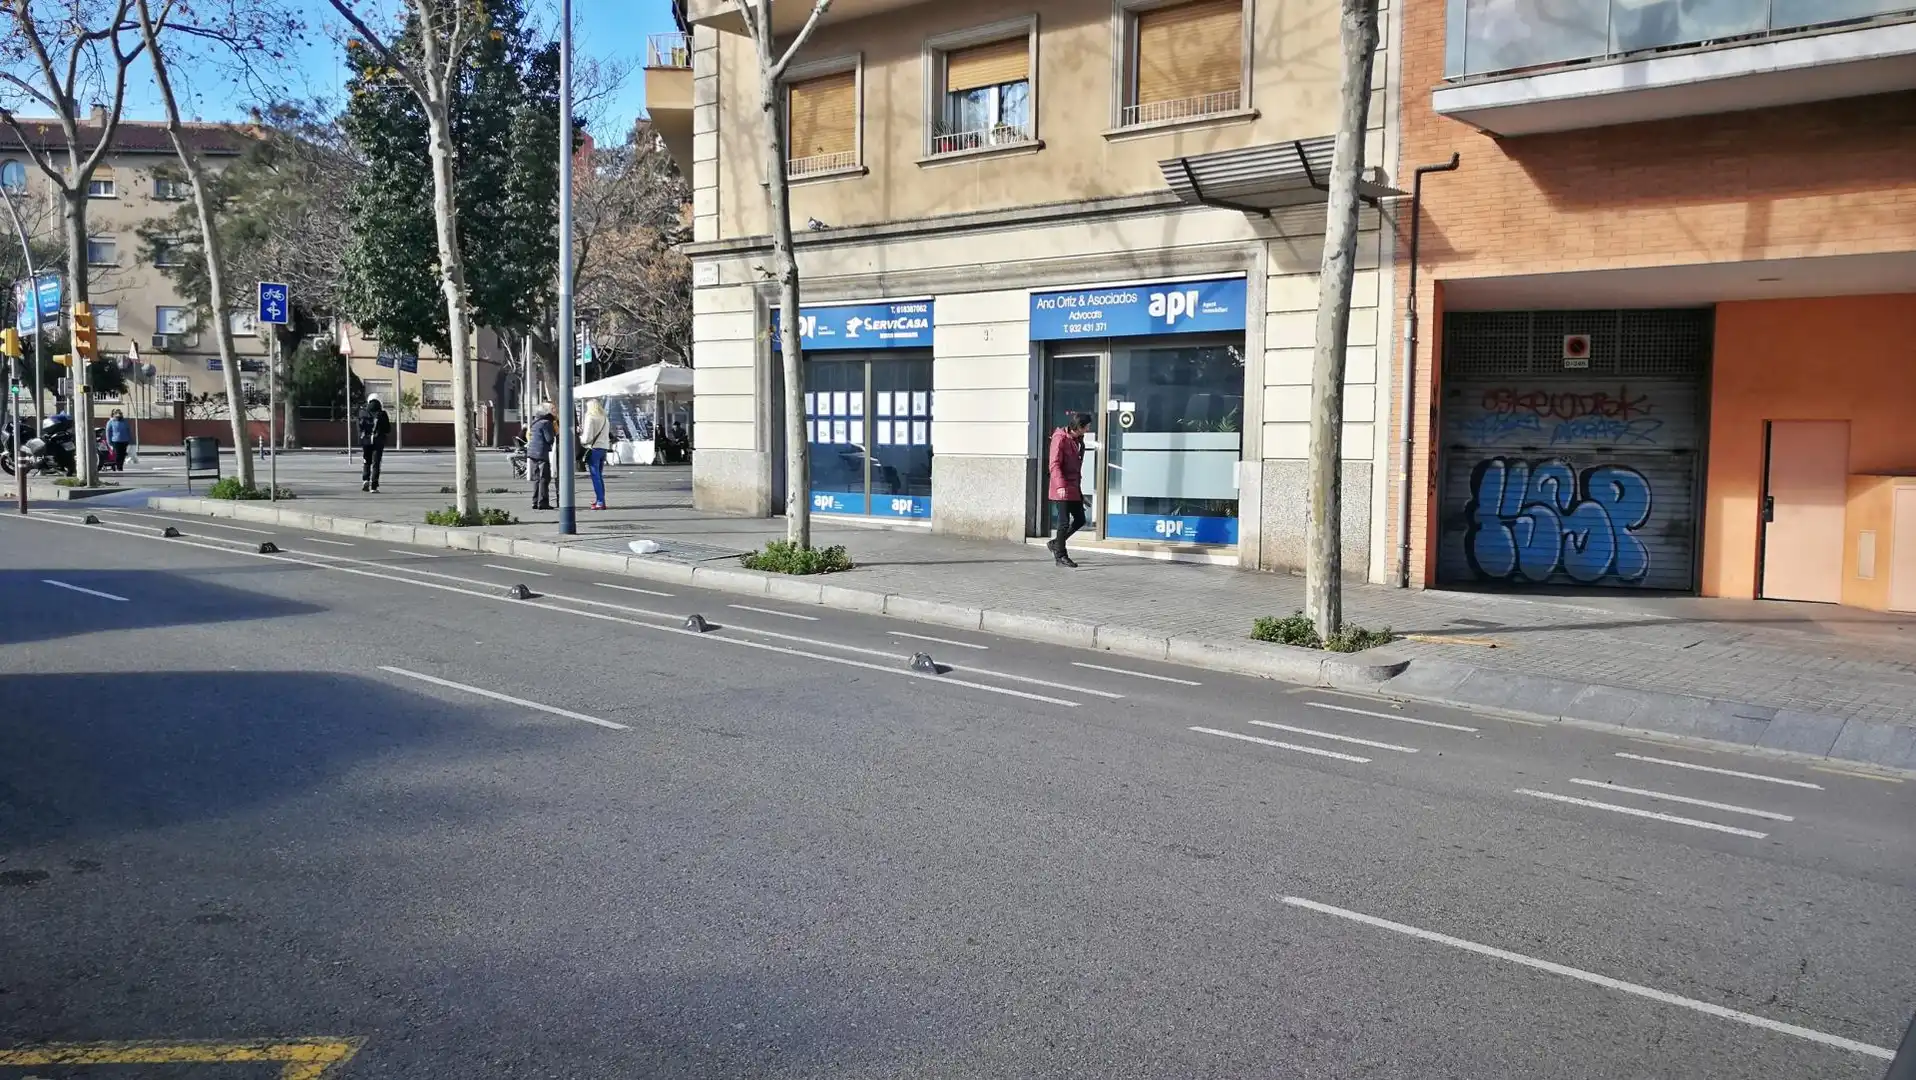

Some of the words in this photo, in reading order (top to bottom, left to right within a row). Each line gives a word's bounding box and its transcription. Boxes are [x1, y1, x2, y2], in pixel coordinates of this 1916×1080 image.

[1037, 298, 1055, 310] Ana
[1057, 295, 1077, 308] Ortiz
[1078, 294, 1085, 307] &
[1087, 291, 1138, 306] Asociados
[1068, 310, 1103, 320] Advocats
[1069, 323, 1082, 333] 932
[1082, 322, 1094, 333] 431
[1096, 322, 1107, 332] 371
